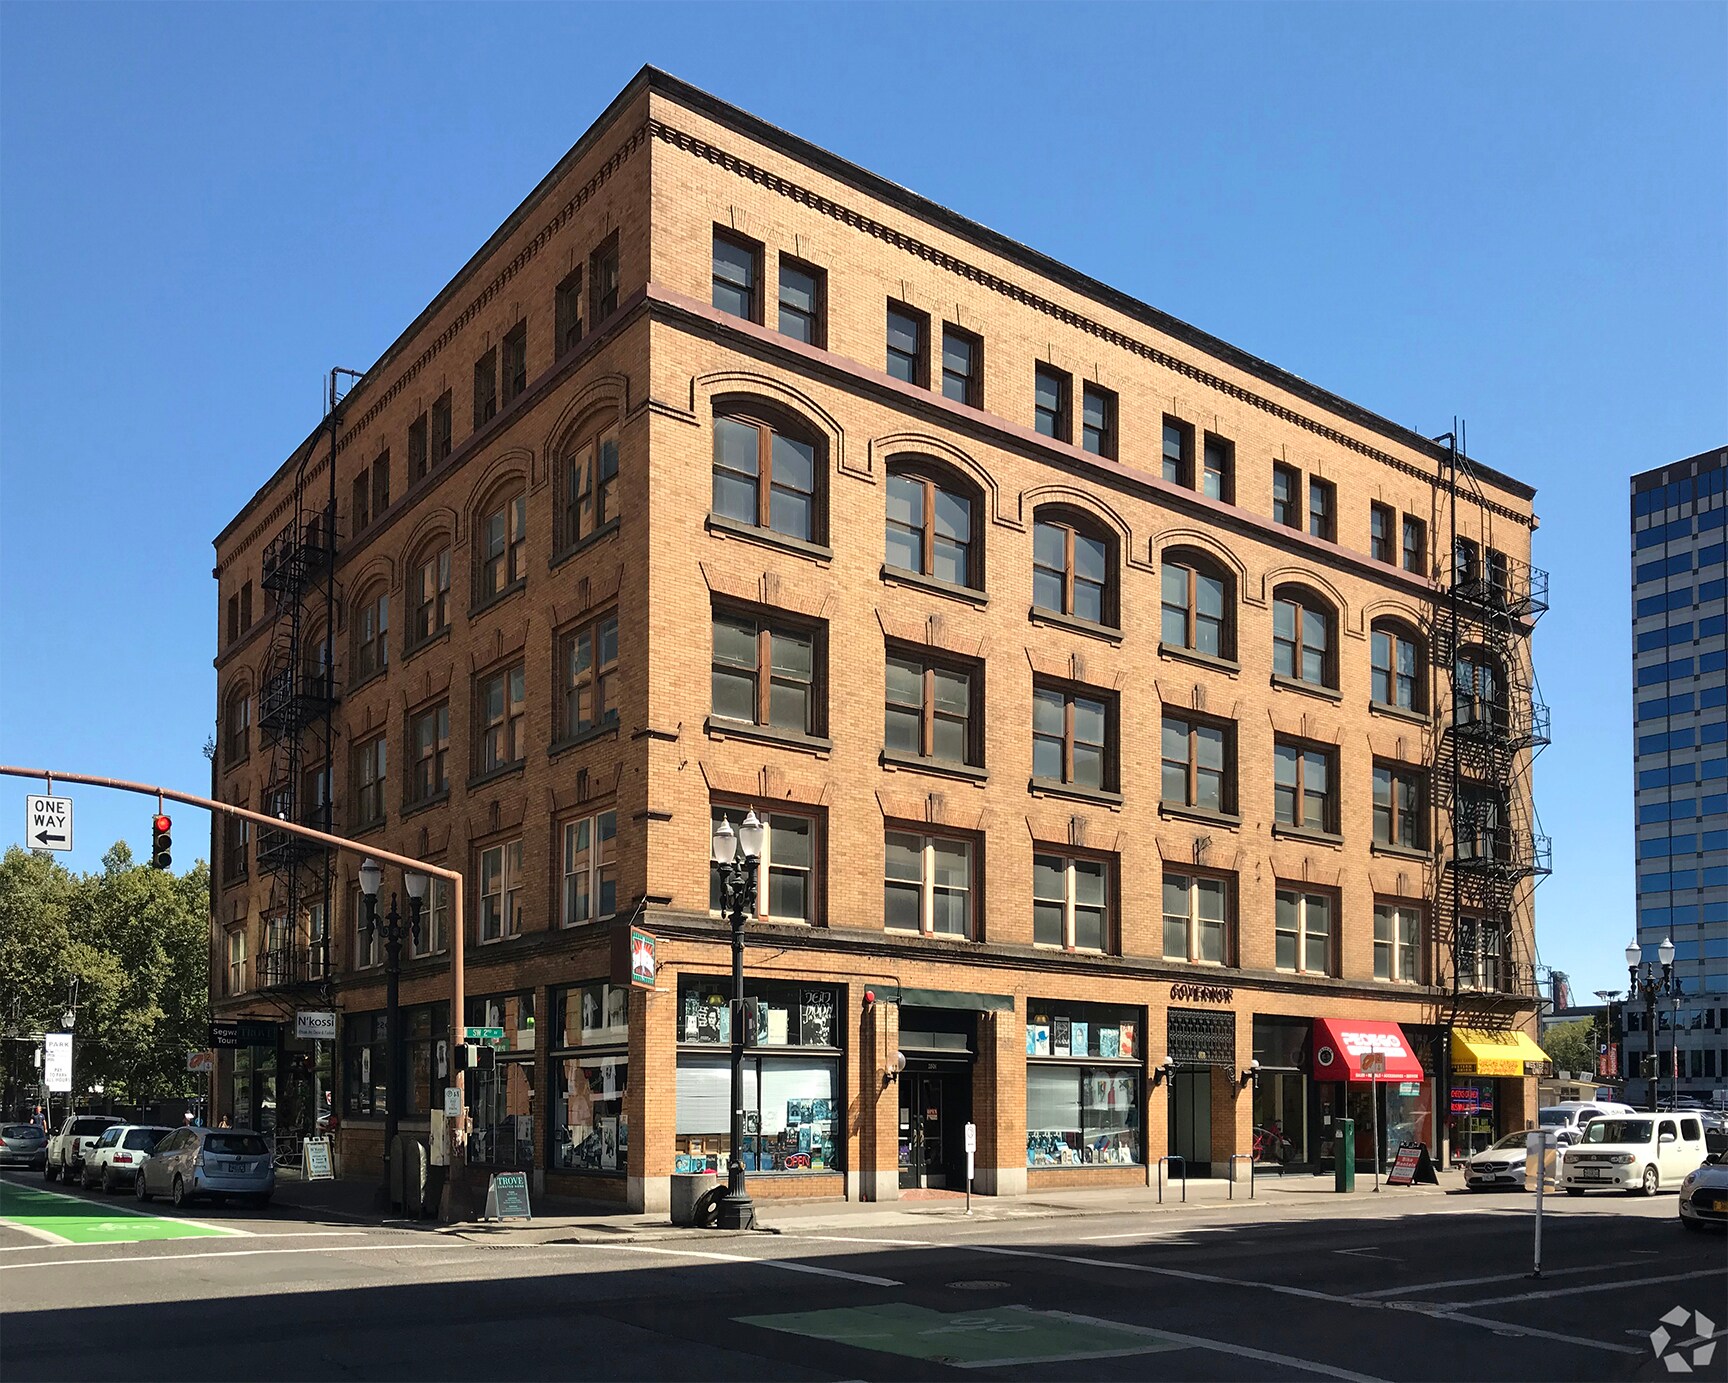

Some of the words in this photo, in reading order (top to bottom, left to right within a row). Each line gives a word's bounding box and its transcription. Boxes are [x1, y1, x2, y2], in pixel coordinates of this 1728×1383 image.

[34, 799, 65, 814] ONE
[34, 814, 66, 828] WAY
[1170, 983, 1234, 1004] GOVERNOR
[298, 1015, 334, 1027] N'kossi
[213, 1028, 237, 1037] Segwa
[472, 1029, 481, 1037] SW
[1600, 1043, 1607, 1054] P
[785, 1156, 811, 1167] OPEN
[496, 1176, 524, 1185] TROVE
